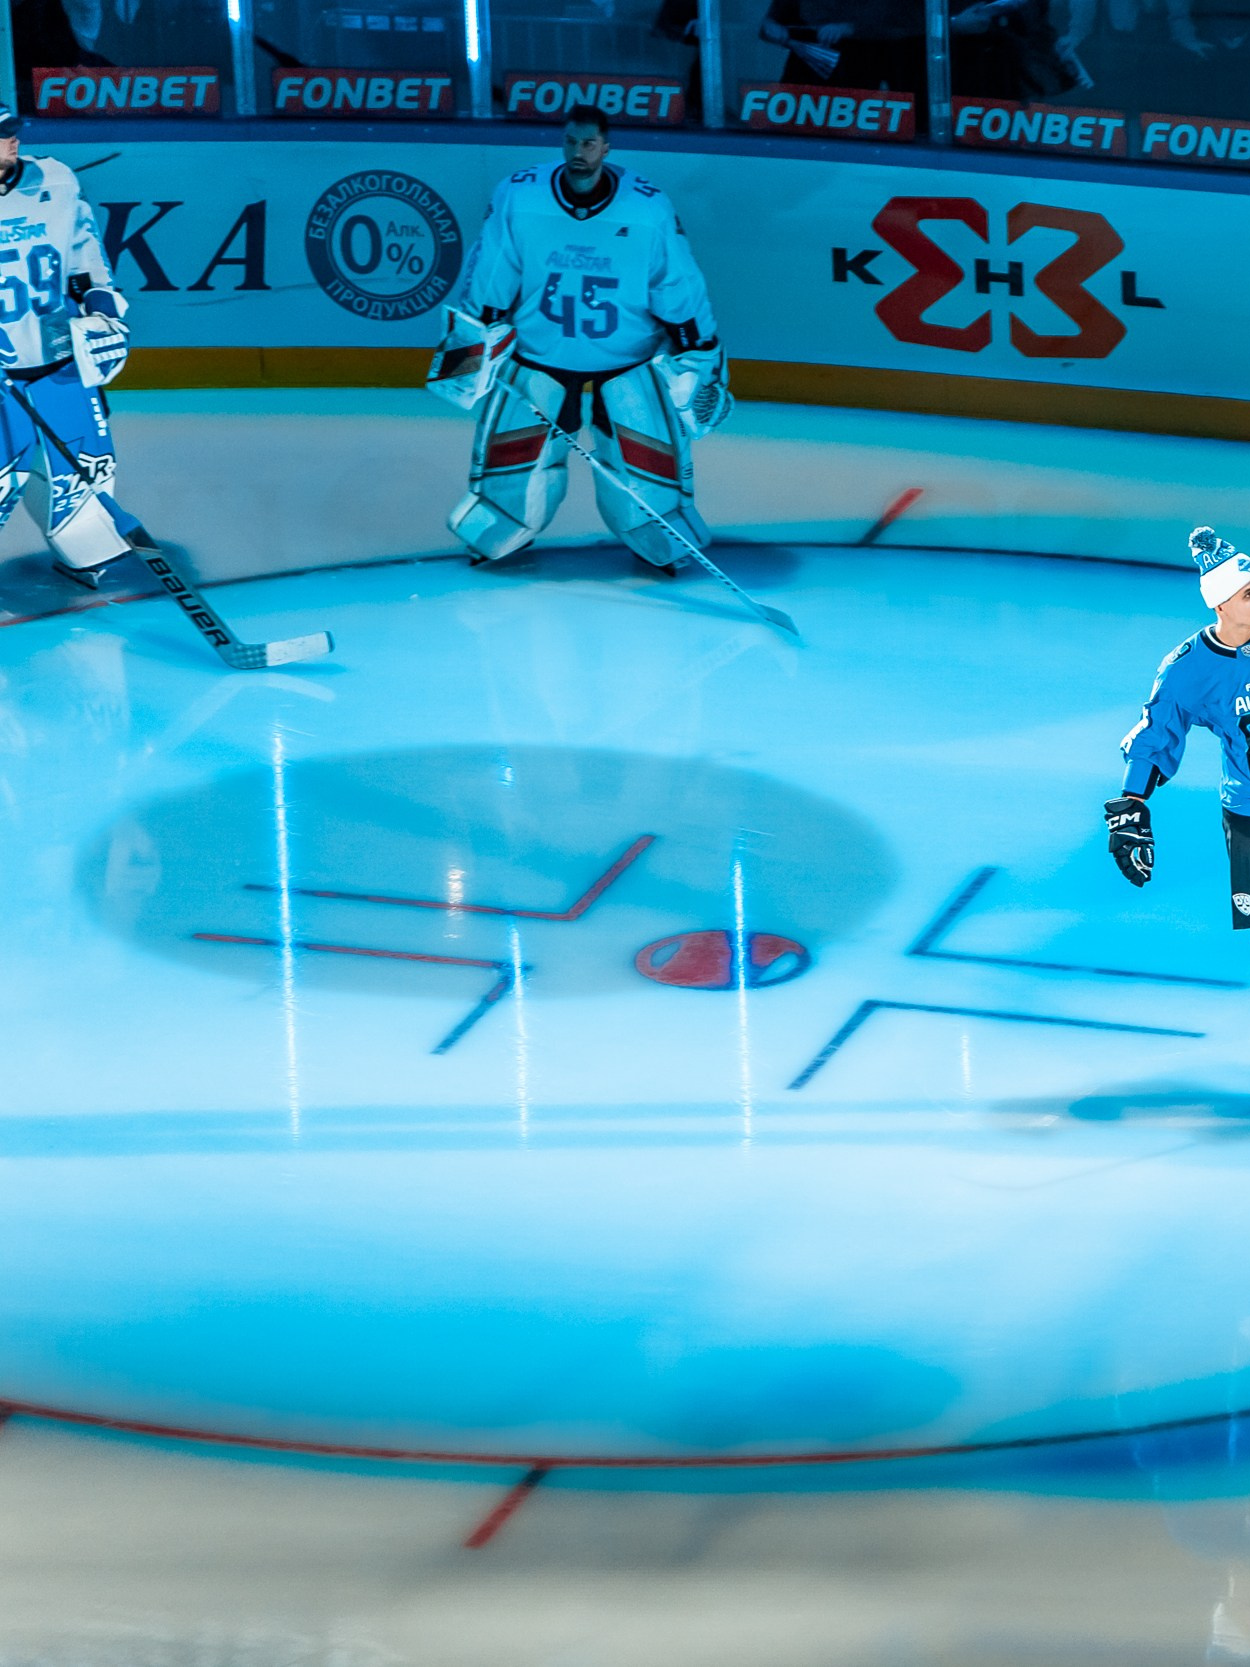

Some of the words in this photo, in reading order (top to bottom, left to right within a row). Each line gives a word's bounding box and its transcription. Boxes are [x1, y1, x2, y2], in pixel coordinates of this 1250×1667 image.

[36, 75, 219, 111] FONBET
[275, 76, 452, 111] FONBET
[507, 80, 681, 118] FONBET
[740, 89, 911, 133] FONBET
[954, 105, 1125, 150] FONBET
[308, 174, 458, 244] БЕЗАЛКОГОЛЬНАЯ
[0, 243, 63, 324] 59
[326, 275, 449, 320] ПРОДУКЦИЯ
[539, 271, 620, 340] 45
[146, 557, 231, 648] BAUER
[1106, 812, 1141, 830] CM
